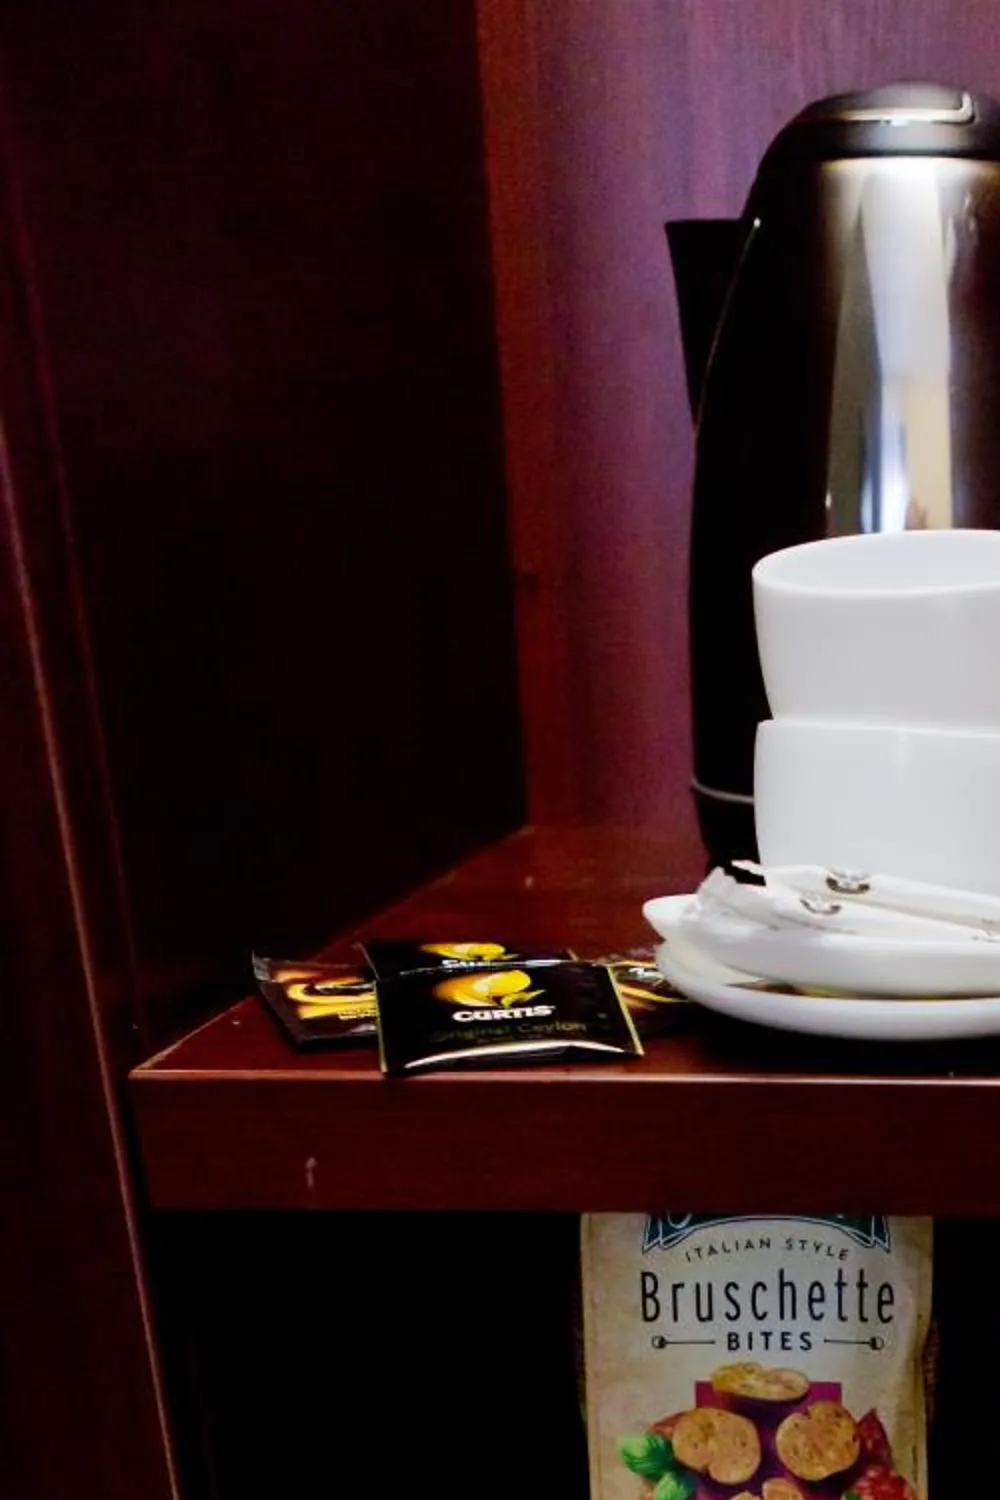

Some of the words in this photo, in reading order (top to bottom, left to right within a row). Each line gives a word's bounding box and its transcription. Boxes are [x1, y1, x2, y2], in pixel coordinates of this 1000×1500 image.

[452, 1004, 553, 1023] CURTIS
[517, 1020, 588, 1035] Ceylon
[684, 1236, 773, 1263] ITALIAN
[785, 1238, 850, 1262] STYLE
[639, 1267, 896, 1324] Bruschette
[726, 1331, 814, 1352] BITES
